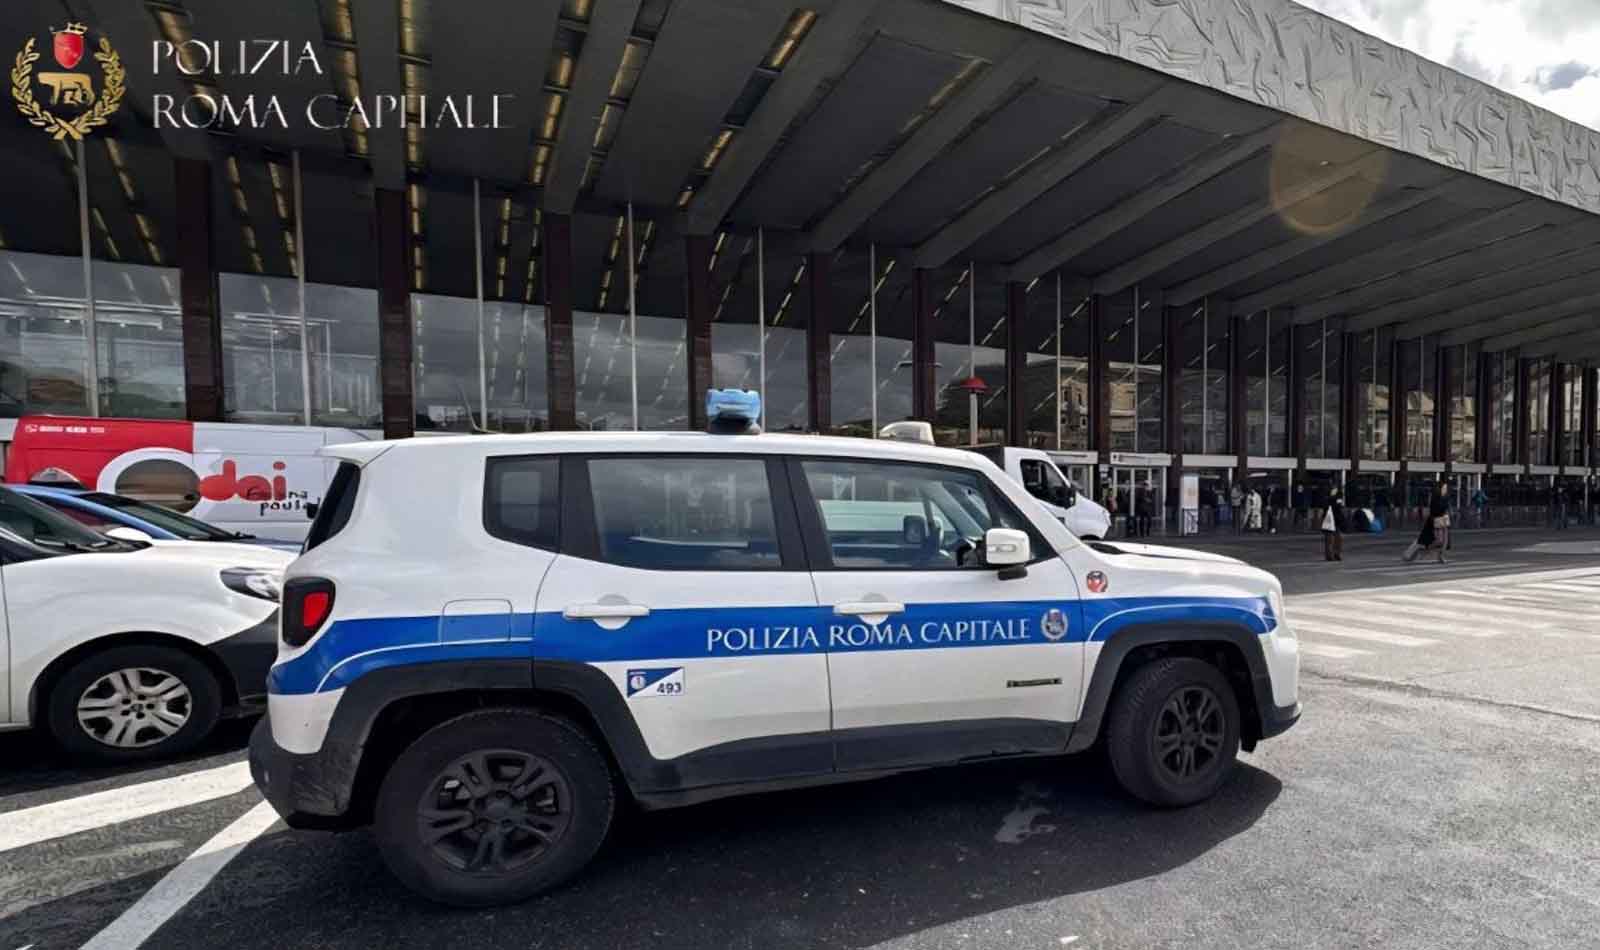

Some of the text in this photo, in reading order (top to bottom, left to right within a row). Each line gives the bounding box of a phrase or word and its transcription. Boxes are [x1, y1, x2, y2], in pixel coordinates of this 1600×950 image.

[706, 618, 1031, 652] POLIZIA ROMA CAPITALE
[656, 682, 682, 694] 493
